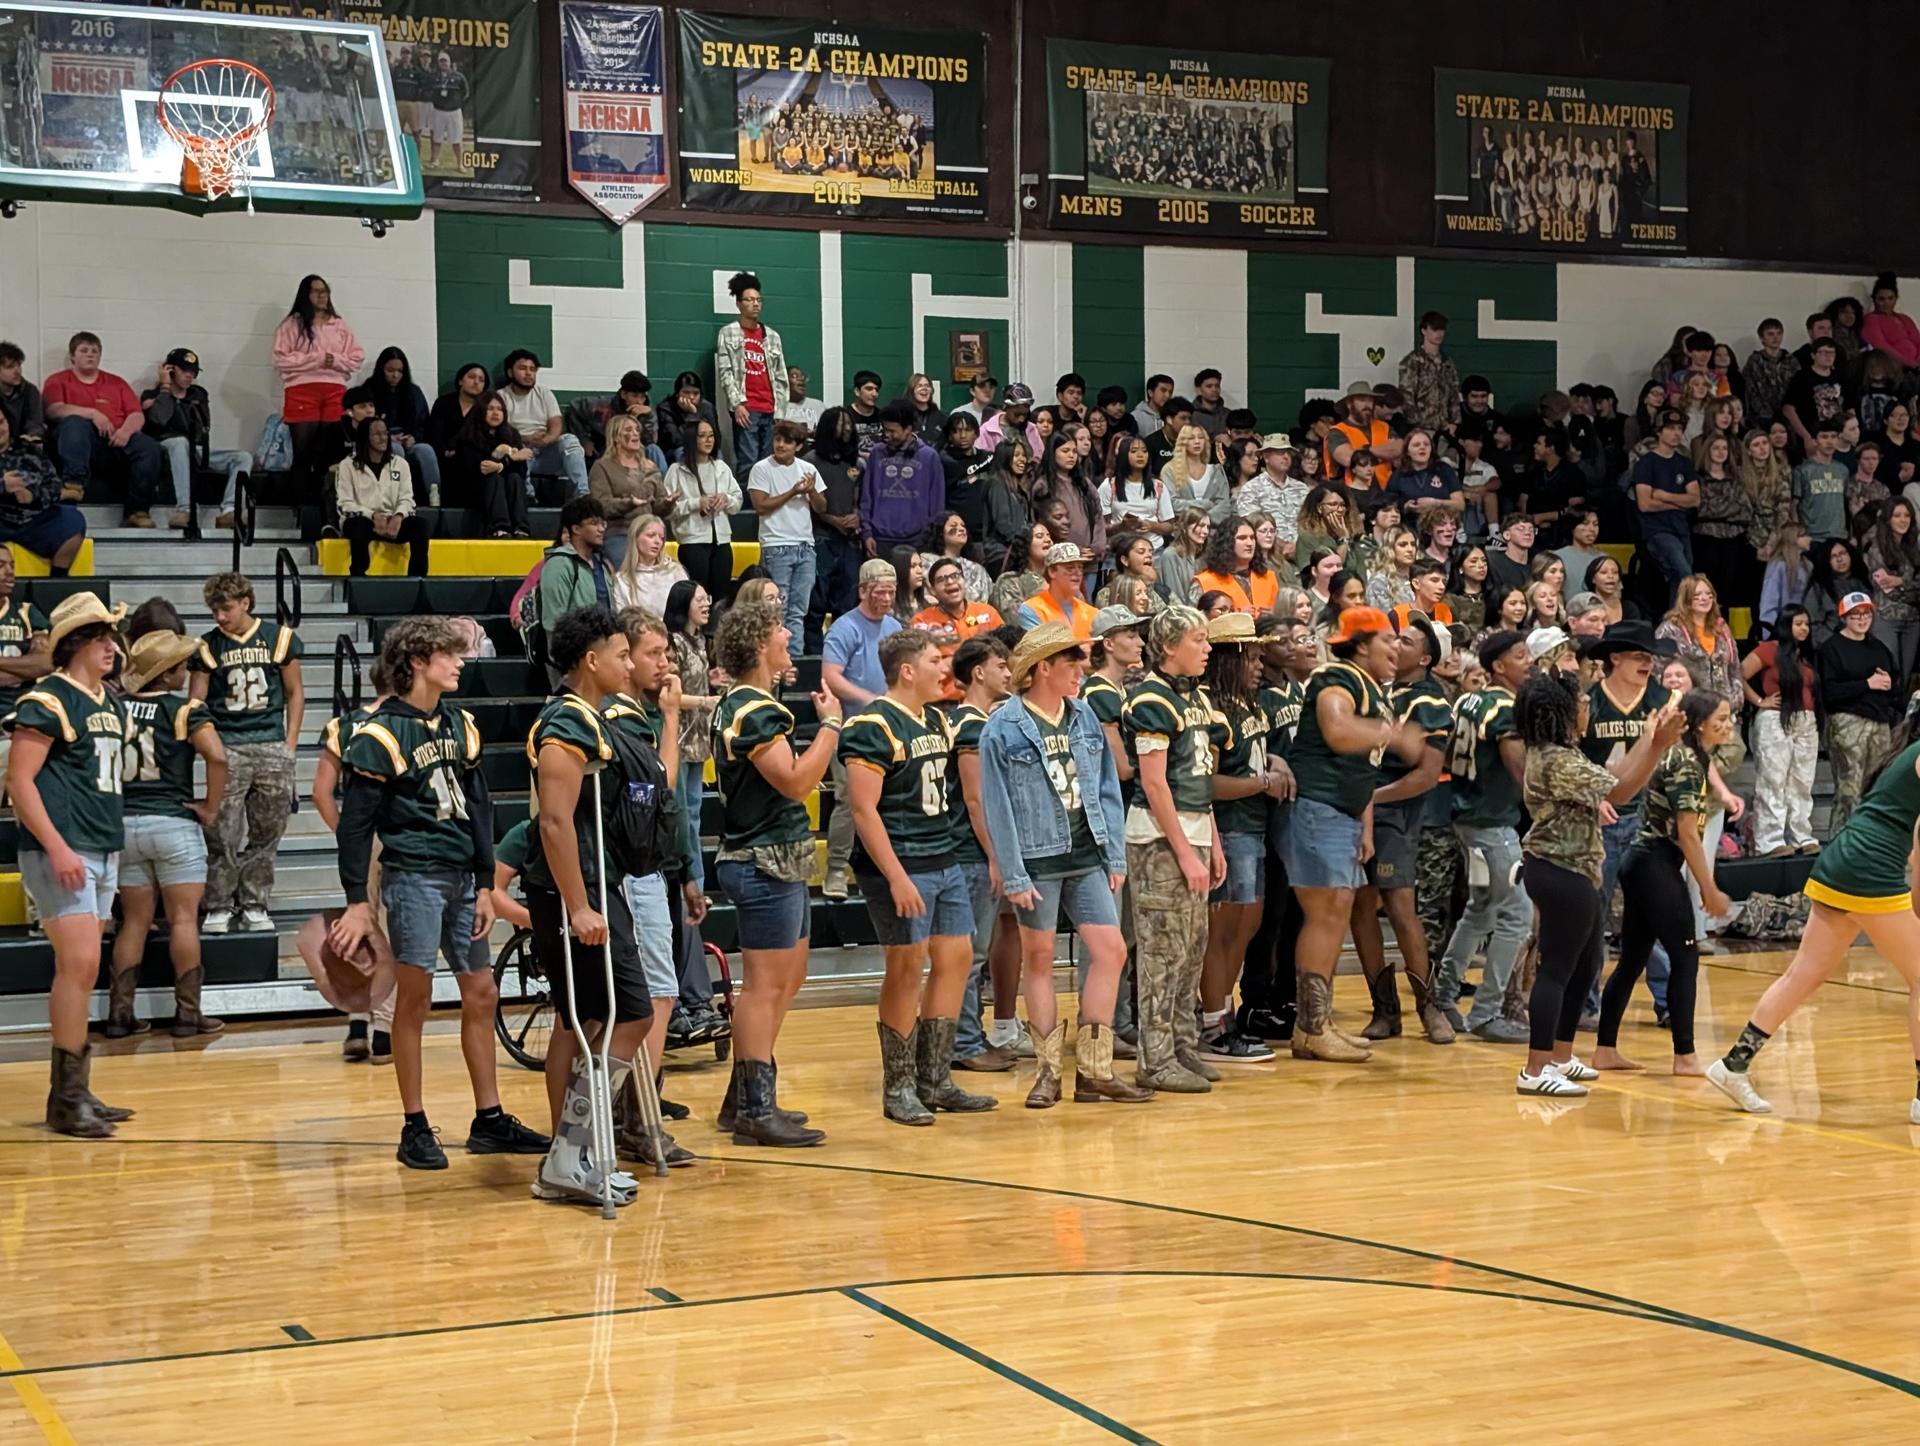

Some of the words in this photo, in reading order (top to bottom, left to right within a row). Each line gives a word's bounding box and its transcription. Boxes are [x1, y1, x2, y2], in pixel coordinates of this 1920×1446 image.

[71, 19, 116, 38] 2016
[813, 32, 860, 46] NCHSAA
[604, 57, 625, 67] 2015
[702, 41, 780, 68] STATE
[789, 47, 822, 73] 2A
[831, 50, 968, 82] CHAMPIONS
[1169, 59, 1210, 73] NCHSAA
[52, 67, 135, 94] NCHSAA
[1066, 65, 1138, 94] STATE
[1145, 72, 1175, 97] 2A
[1182, 75, 1309, 105] CHAMPIONS
[1547, 86, 1586, 99] NCHSAA
[578, 104, 652, 132] NCHSAA
[1455, 94, 1520, 121] STATE
[1527, 100, 1554, 122] 2A
[1562, 102, 1674, 129] CHAMPIONS
[462, 152, 500, 169] GOLF
[690, 168, 752, 186] WOMENS
[594, 191, 644, 200] ASSOCIATION
[601, 184, 635, 192] ATHLETIC
[813, 181, 862, 205] 2015
[889, 179, 978, 197] BASKETBALL
[1060, 195, 1123, 217] MENS
[1158, 200, 1209, 224] 2005
[1240, 204, 1316, 226] SOCCER
[1446, 214, 1503, 232] WOMENS
[1539, 220, 1588, 243] 2002
[1630, 223, 1677, 240] TENNIS
[225, 666, 269, 711] 32
[123, 700, 159, 720] MITH
[1595, 721, 1624, 739] WILKES
